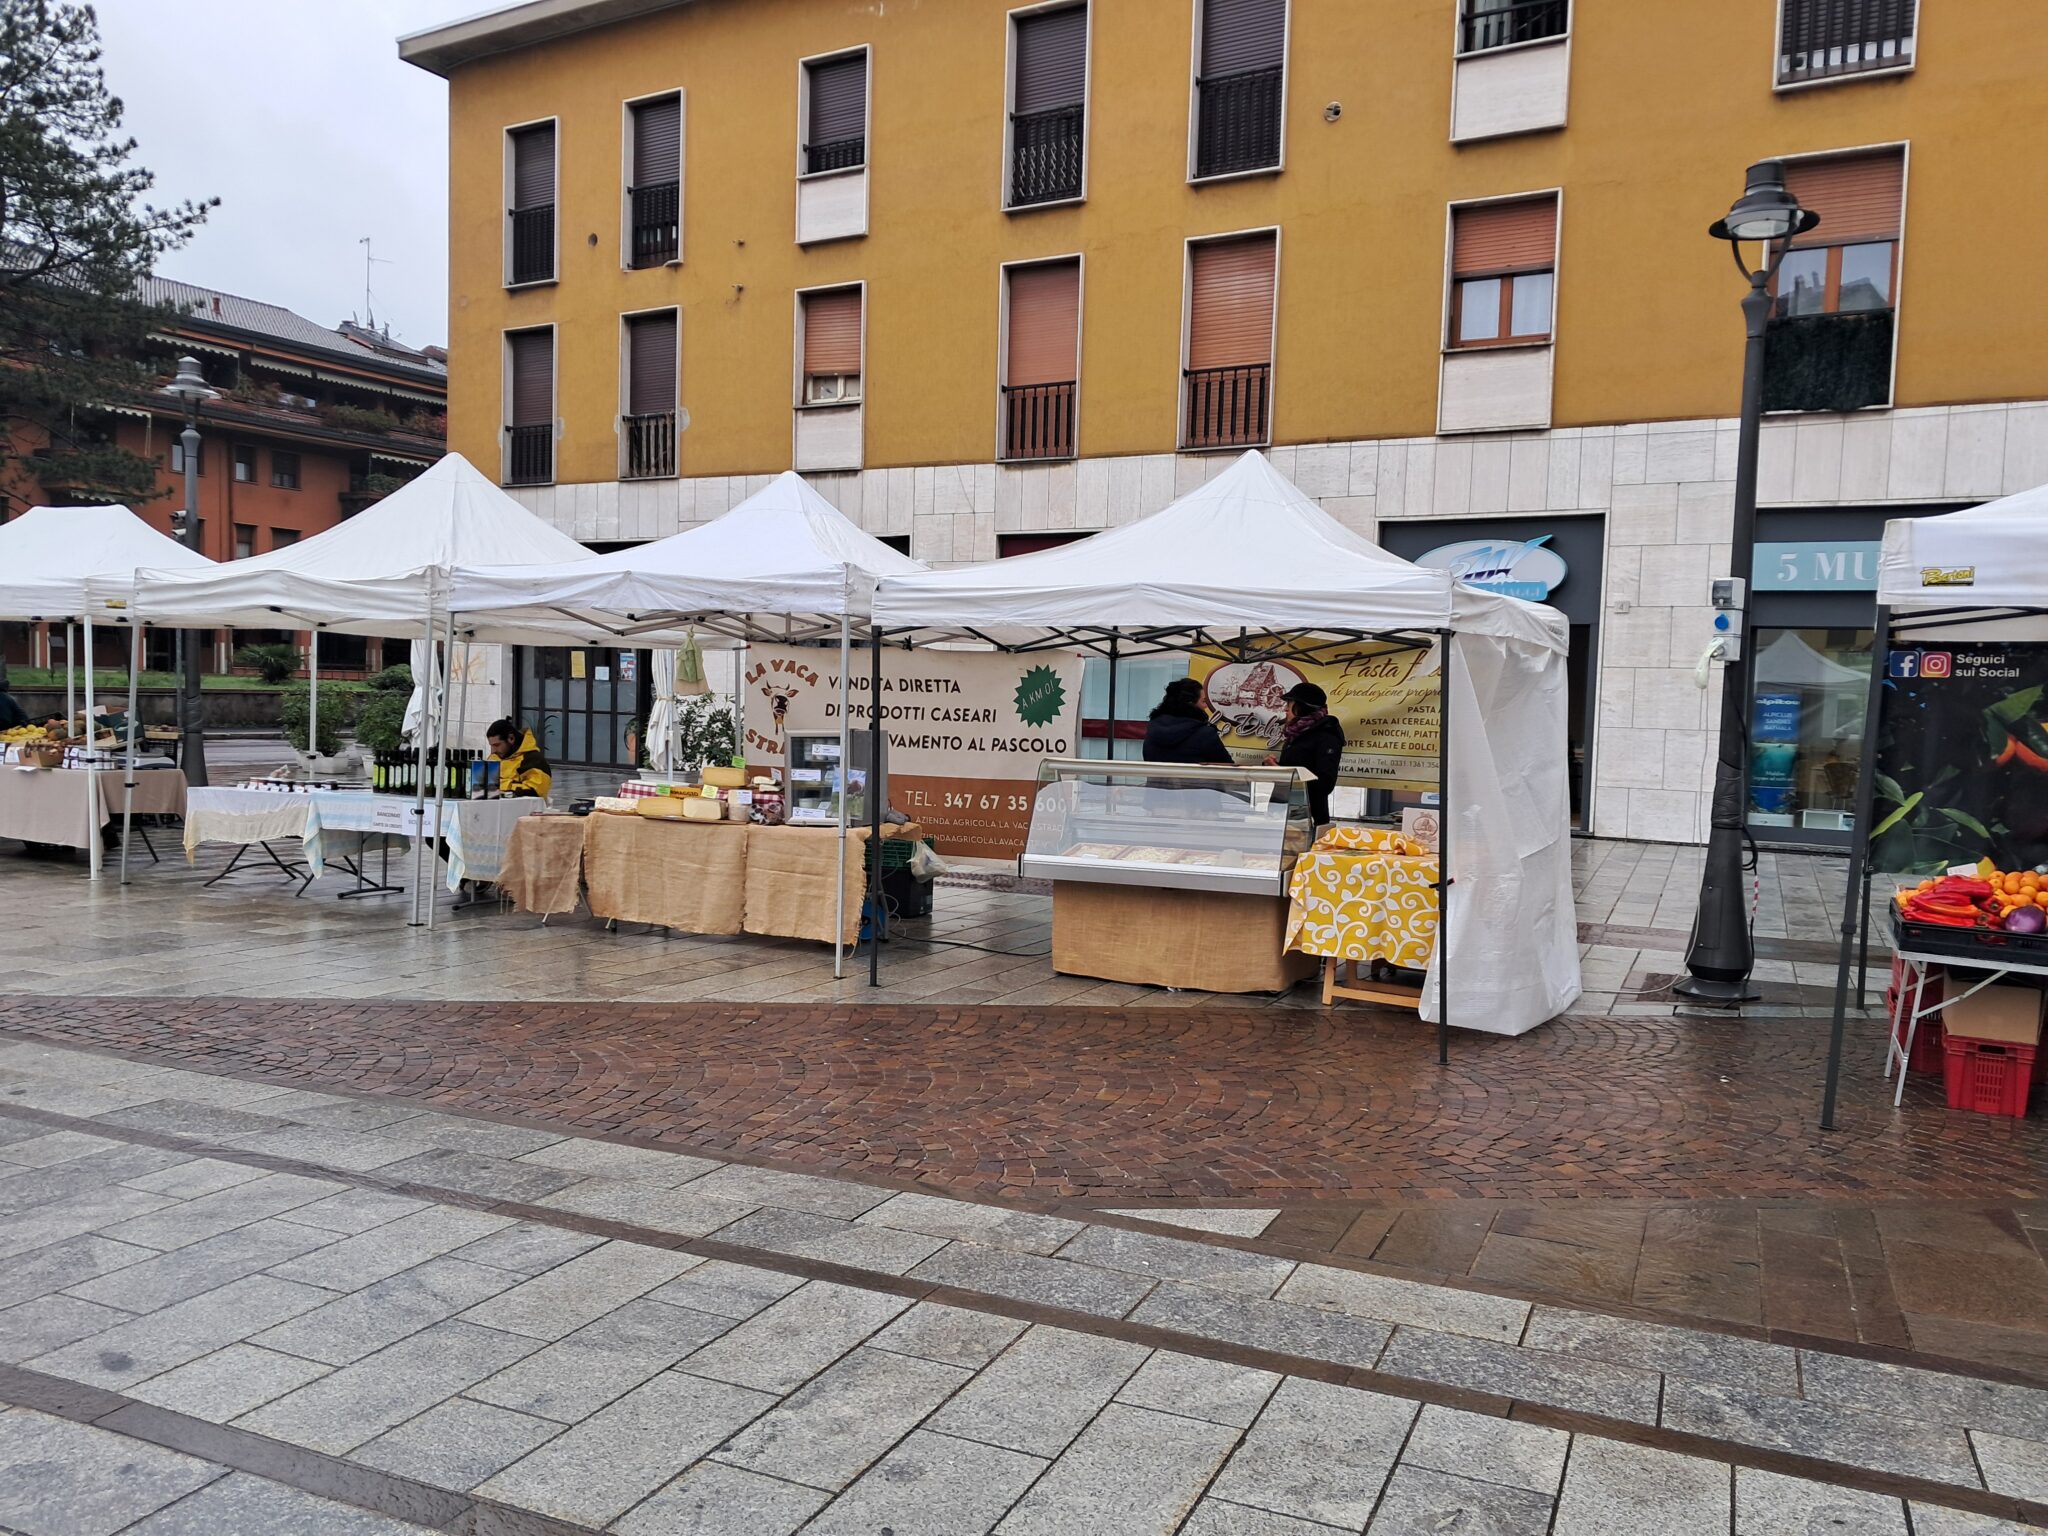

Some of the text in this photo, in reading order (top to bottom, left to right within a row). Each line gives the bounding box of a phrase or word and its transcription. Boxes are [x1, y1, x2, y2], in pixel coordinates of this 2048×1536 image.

[1777, 553, 1798, 582] 5
[1921, 566, 1975, 586] Bertoni
[1334, 651, 1400, 680] Pasta
[1956, 654, 2006, 666] Seguici
[744, 658, 819, 688] LA VACA
[1955, 667, 2020, 678] sui Social
[828, 675, 961, 694] VNDA DIRETTA
[1329, 681, 1440, 705] di produzione propr
[1022, 697, 1029, 710] A
[1029, 687, 1043, 705] KM
[1755, 698, 1800, 706] alpitou
[825, 703, 841, 717] DI
[930, 707, 997, 723] CASEARI
[1408, 706, 1436, 714] PASTA
[1234, 712, 1286, 749] Deliz
[1360, 718, 1388, 726] PASTA
[1402, 718, 1440, 727] CEREALI,
[888, 733, 1067, 753] VAMENTO AL PASCOLO
[1371, 729, 1440, 738] GNOCCHI, PIATT
[1343, 740, 1365, 748] RTE
[1367, 740, 1399, 749] SALATE
[1409, 743, 1438, 752] DOLCI,
[1357, 767, 1396, 775] MATTINA
[904, 790, 1067, 812] TEL. 347 67 35 600
[915, 816, 950, 826] AZIENDA
[953, 818, 996, 828] AGRICOLA
[999, 820, 1009, 829] LA
